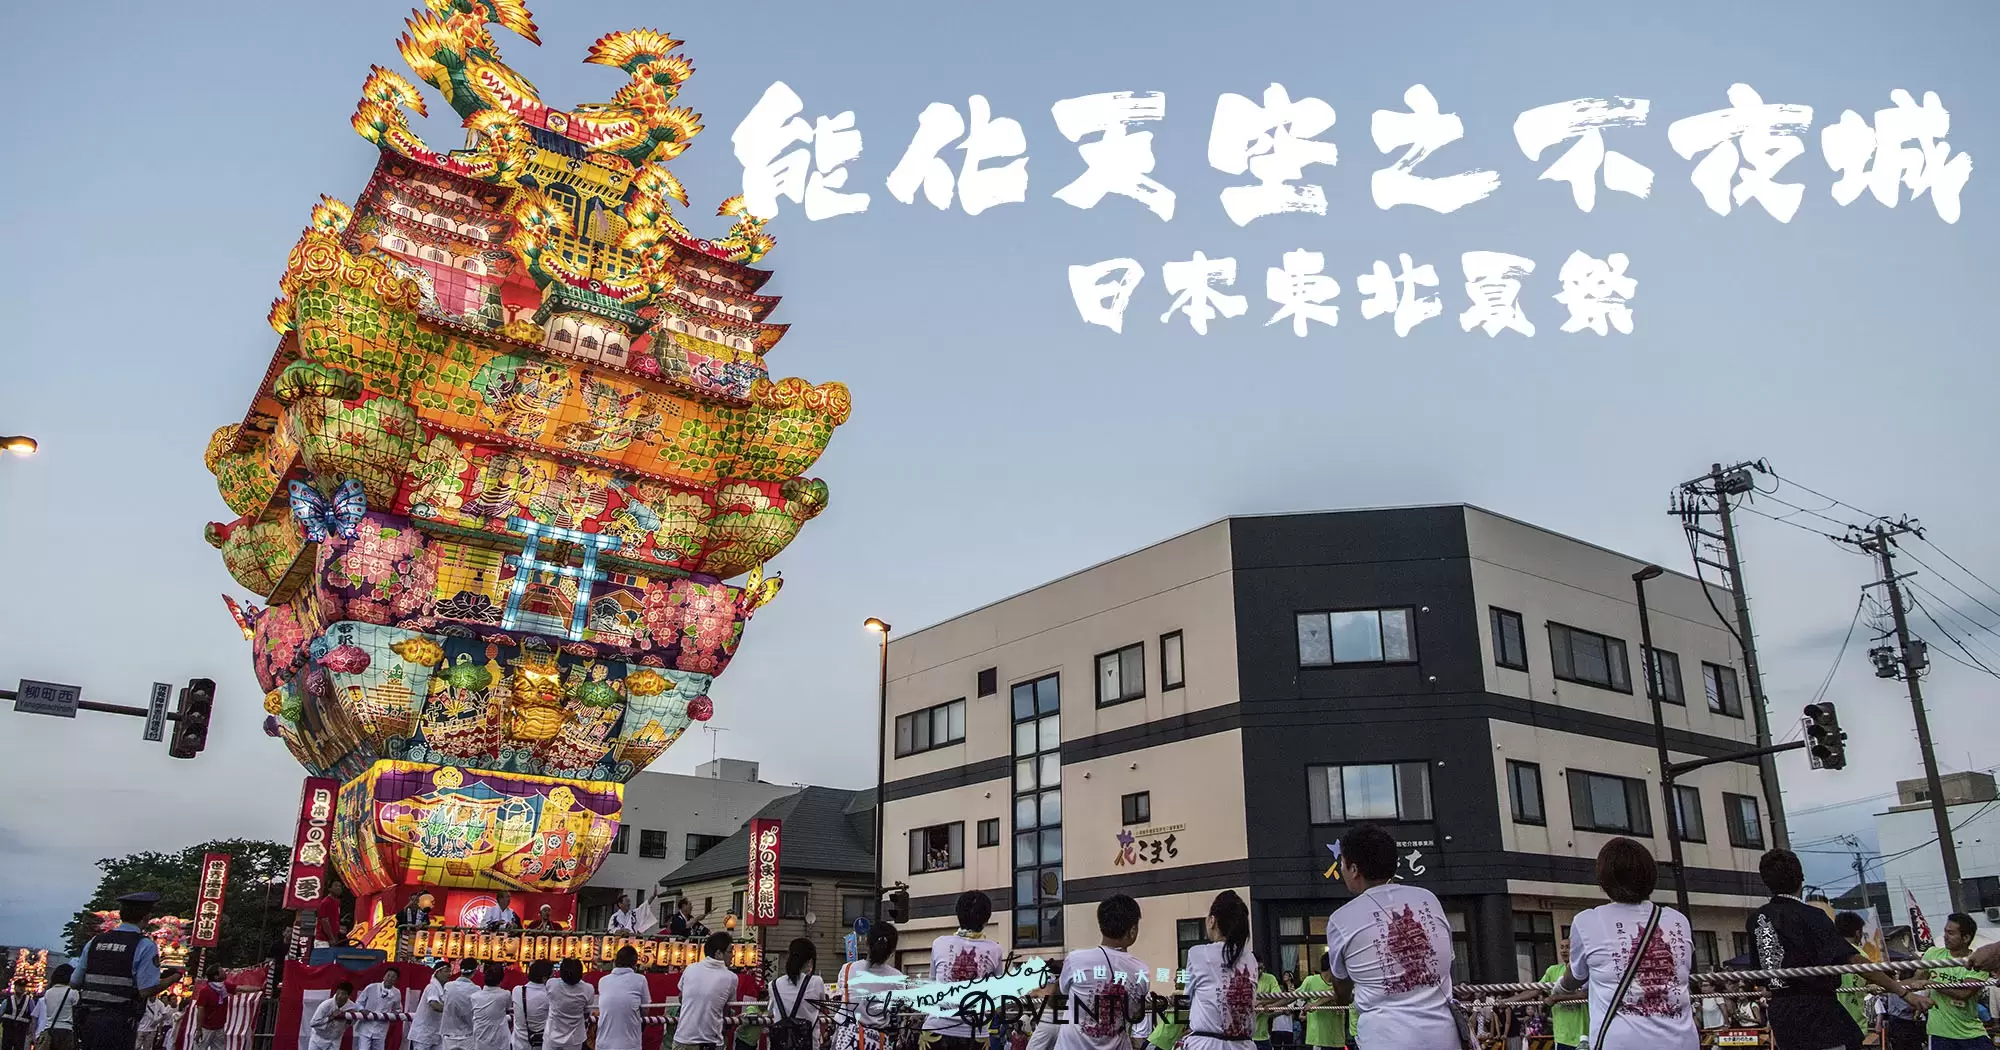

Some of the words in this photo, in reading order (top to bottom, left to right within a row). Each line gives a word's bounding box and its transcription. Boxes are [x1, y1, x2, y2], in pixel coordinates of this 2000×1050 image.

[24, 684, 74, 703] 柳町西
[294, 788, 331, 899] 日本一の愛季
[1114, 829, 1178, 867] 花こまち
